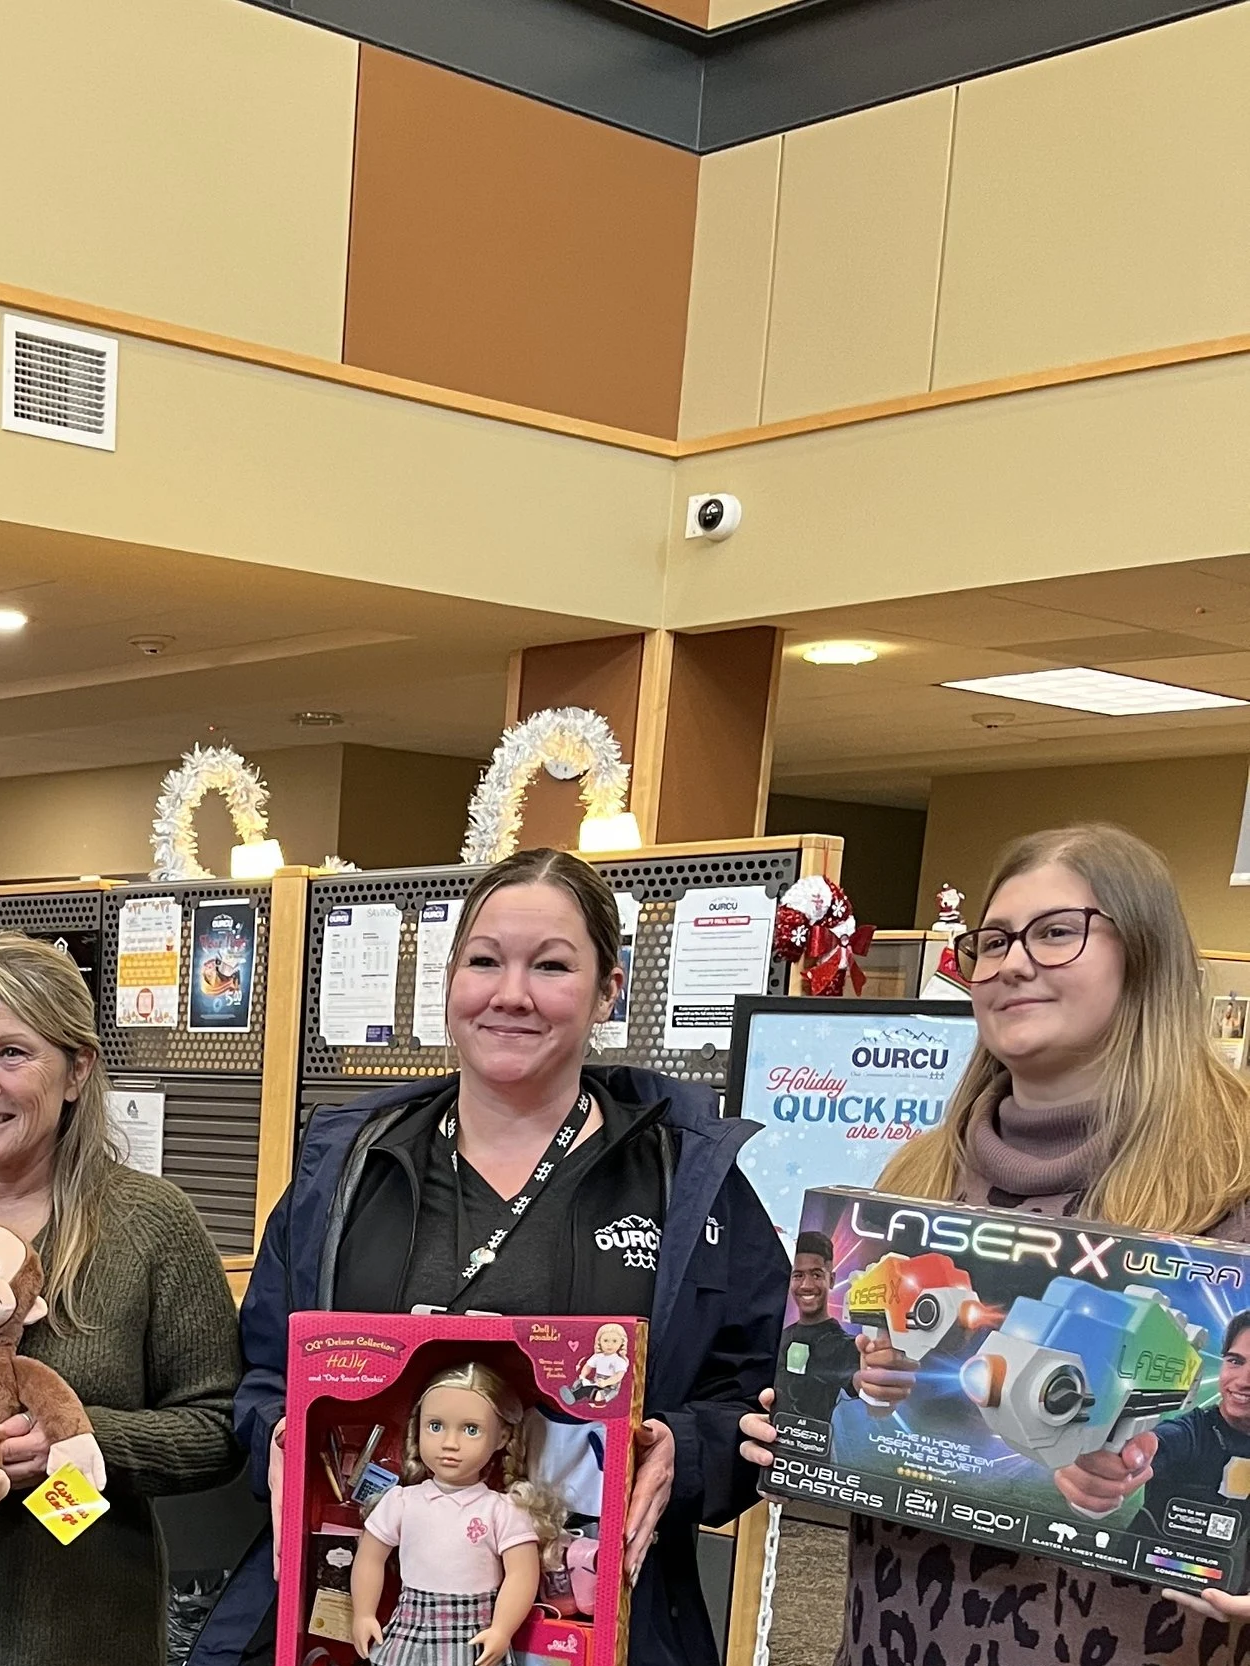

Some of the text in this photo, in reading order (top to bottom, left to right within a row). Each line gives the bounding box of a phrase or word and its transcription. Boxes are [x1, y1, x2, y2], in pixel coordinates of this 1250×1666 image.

[852, 1046, 949, 1070] OURCU
[766, 1066, 848, 1098] Holiday
[773, 1094, 943, 1125] QUICK BU
[846, 1125, 880, 1139] are
[595, 1230, 660, 1250] OURC
[851, 1203, 1115, 1279] LASER X
[1123, 1250, 1243, 1289] ULTRA
[325, 1337, 355, 1347] Deluxe
[357, 1337, 395, 1353] Collection
[1116, 1343, 1186, 1384] LASER
[797, 1418, 807, 1426] All
[869, 1433, 994, 1468] LASER TAG SYSTEM
[877, 1445, 899, 1456] ON
[900, 1449, 924, 1461] THE
[894, 1430, 920, 1441] THE
[933, 1438, 971, 1453] HOME
[772, 1457, 861, 1488] DOUBLE
[53, 1480, 89, 1519] Curius
[770, 1471, 884, 1508] BLASTERS
[905, 1493, 924, 1510] 2
[45, 1490, 78, 1525] Geoge
[906, 1508, 934, 1520] PLAYERS
[972, 1524, 995, 1534] RANGE
[1032, 1537, 1062, 1549] BLASTER
[1071, 1547, 1093, 1557] CHEST
[1094, 1553, 1129, 1566] RECEIVER
[1153, 1546, 1219, 1567] 20+ TEAM COLOR
